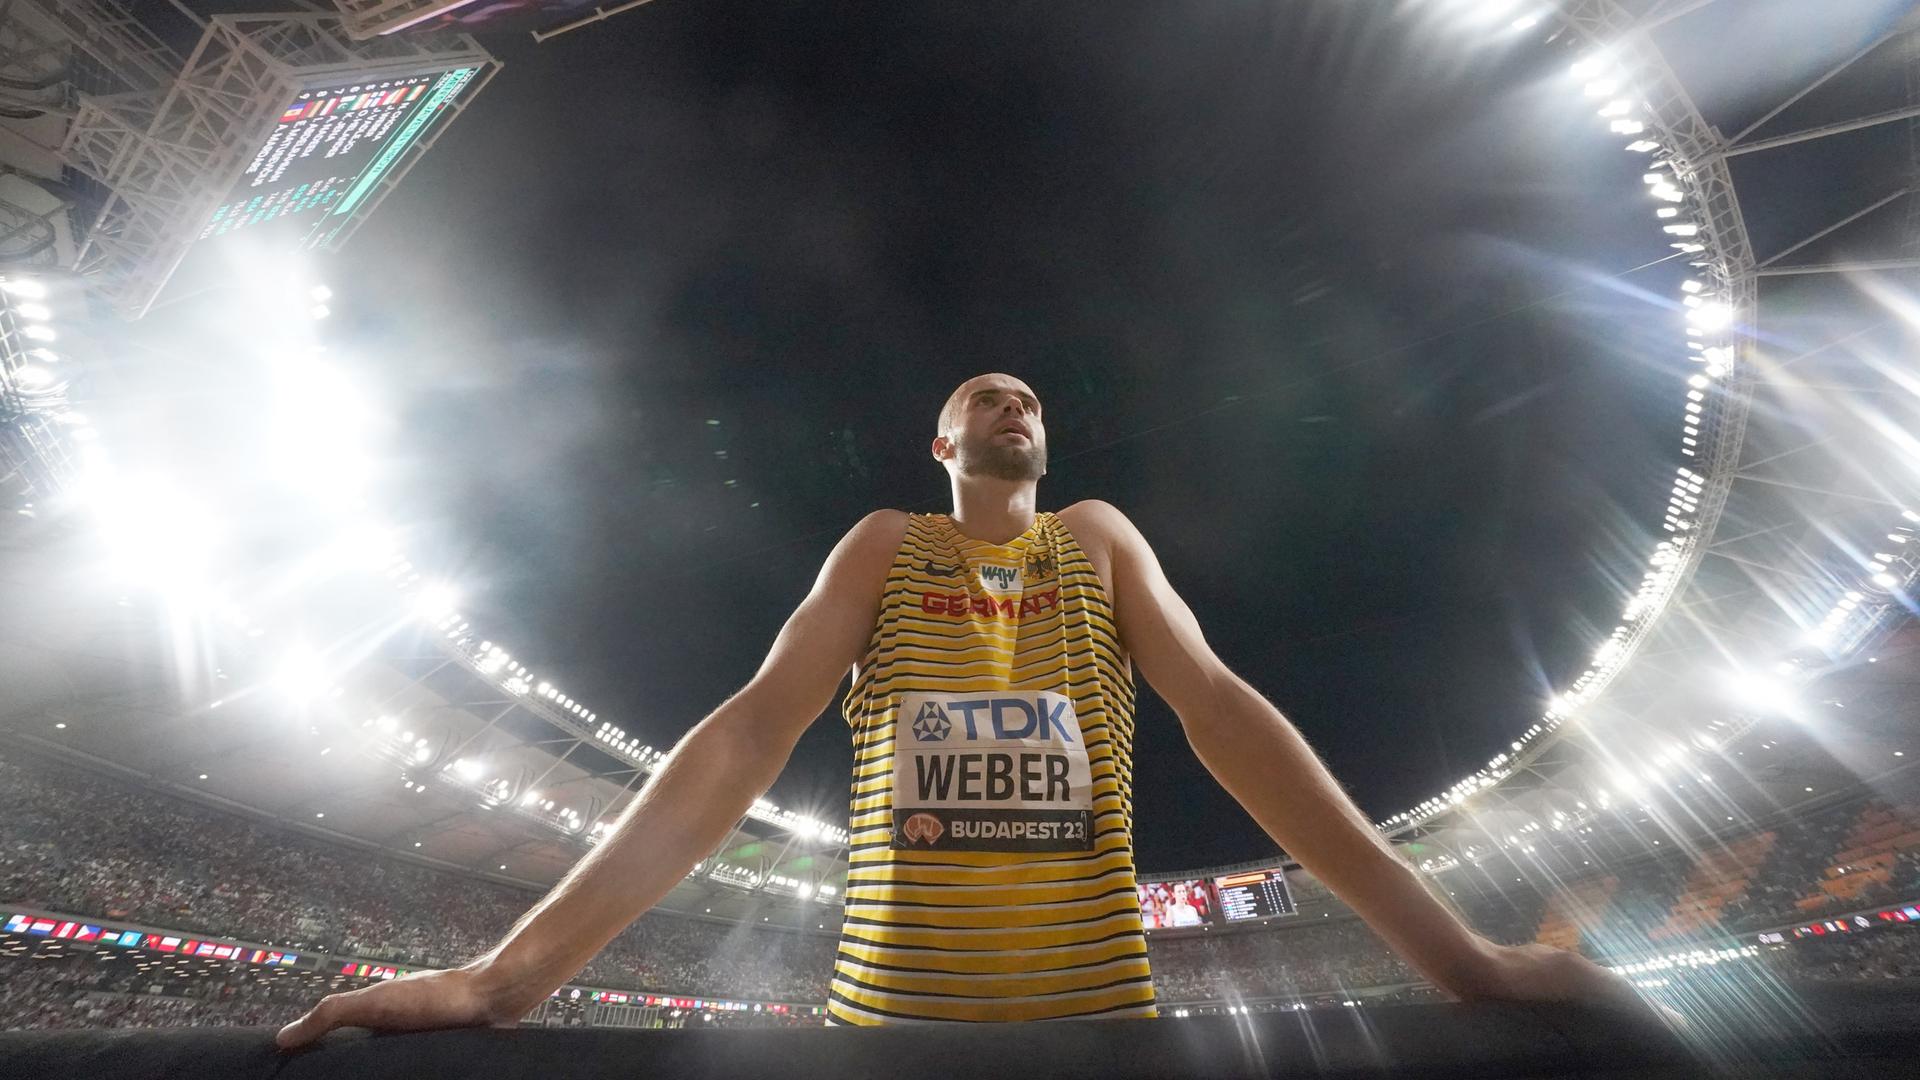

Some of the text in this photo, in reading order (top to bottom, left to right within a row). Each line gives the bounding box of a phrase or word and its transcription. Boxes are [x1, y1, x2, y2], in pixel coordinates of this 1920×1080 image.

[921, 585, 1060, 620] GERMANY
[946, 698, 1073, 742] TDK
[915, 753, 1071, 802] WEBER
[951, 821, 1085, 839] BUDAPEST 23
